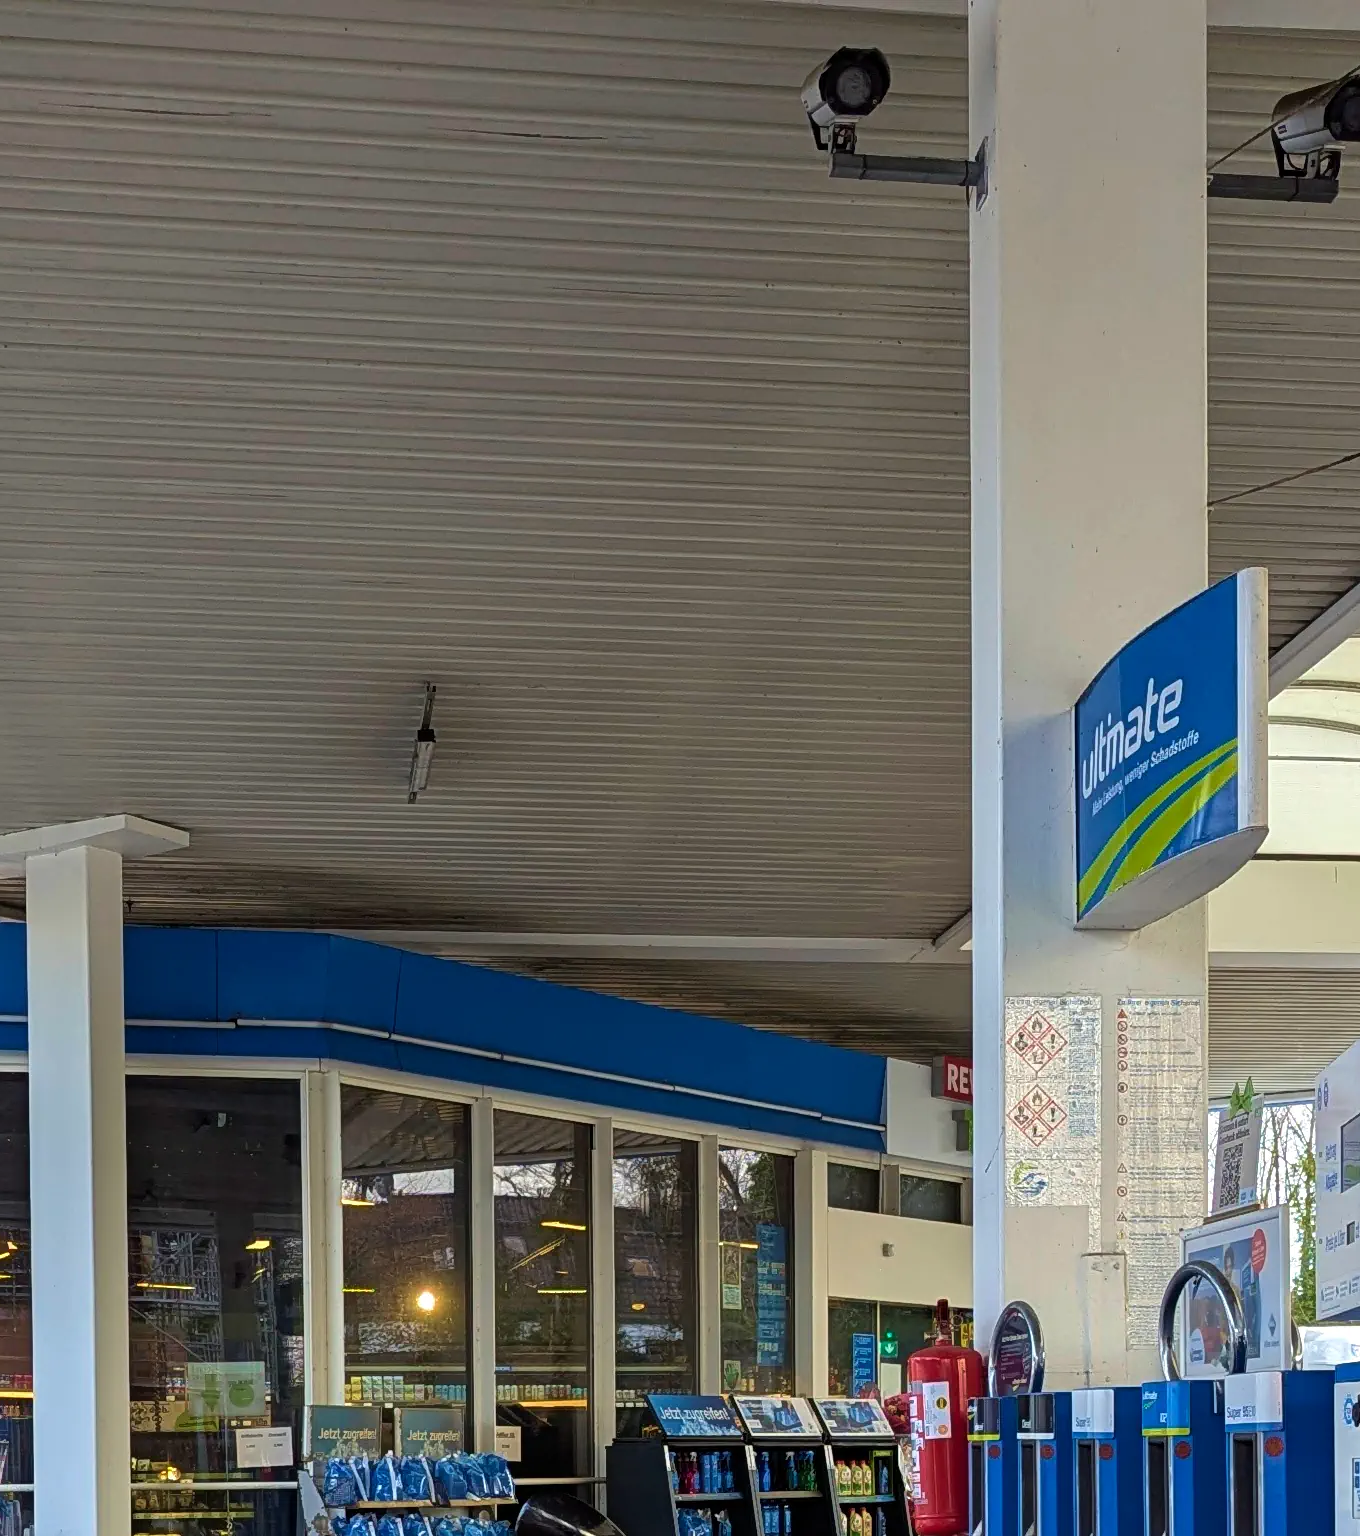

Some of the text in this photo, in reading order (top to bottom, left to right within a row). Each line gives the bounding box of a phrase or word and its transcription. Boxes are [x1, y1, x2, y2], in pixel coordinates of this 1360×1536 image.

[1082, 678, 1183, 799] ultimate
[1124, 759, 1149, 786] weniger
[1150, 729, 1200, 768] Schadstoffe
[947, 1063, 973, 1095] RE
[660, 1406, 681, 1421] Jetzt
[683, 1408, 731, 1426] zugreifen!
[1226, 1406, 1242, 1420] Super
[317, 1427, 377, 1443] Jetzt zugreifen!
[406, 1429, 461, 1443] Jetzt zugreifen!
